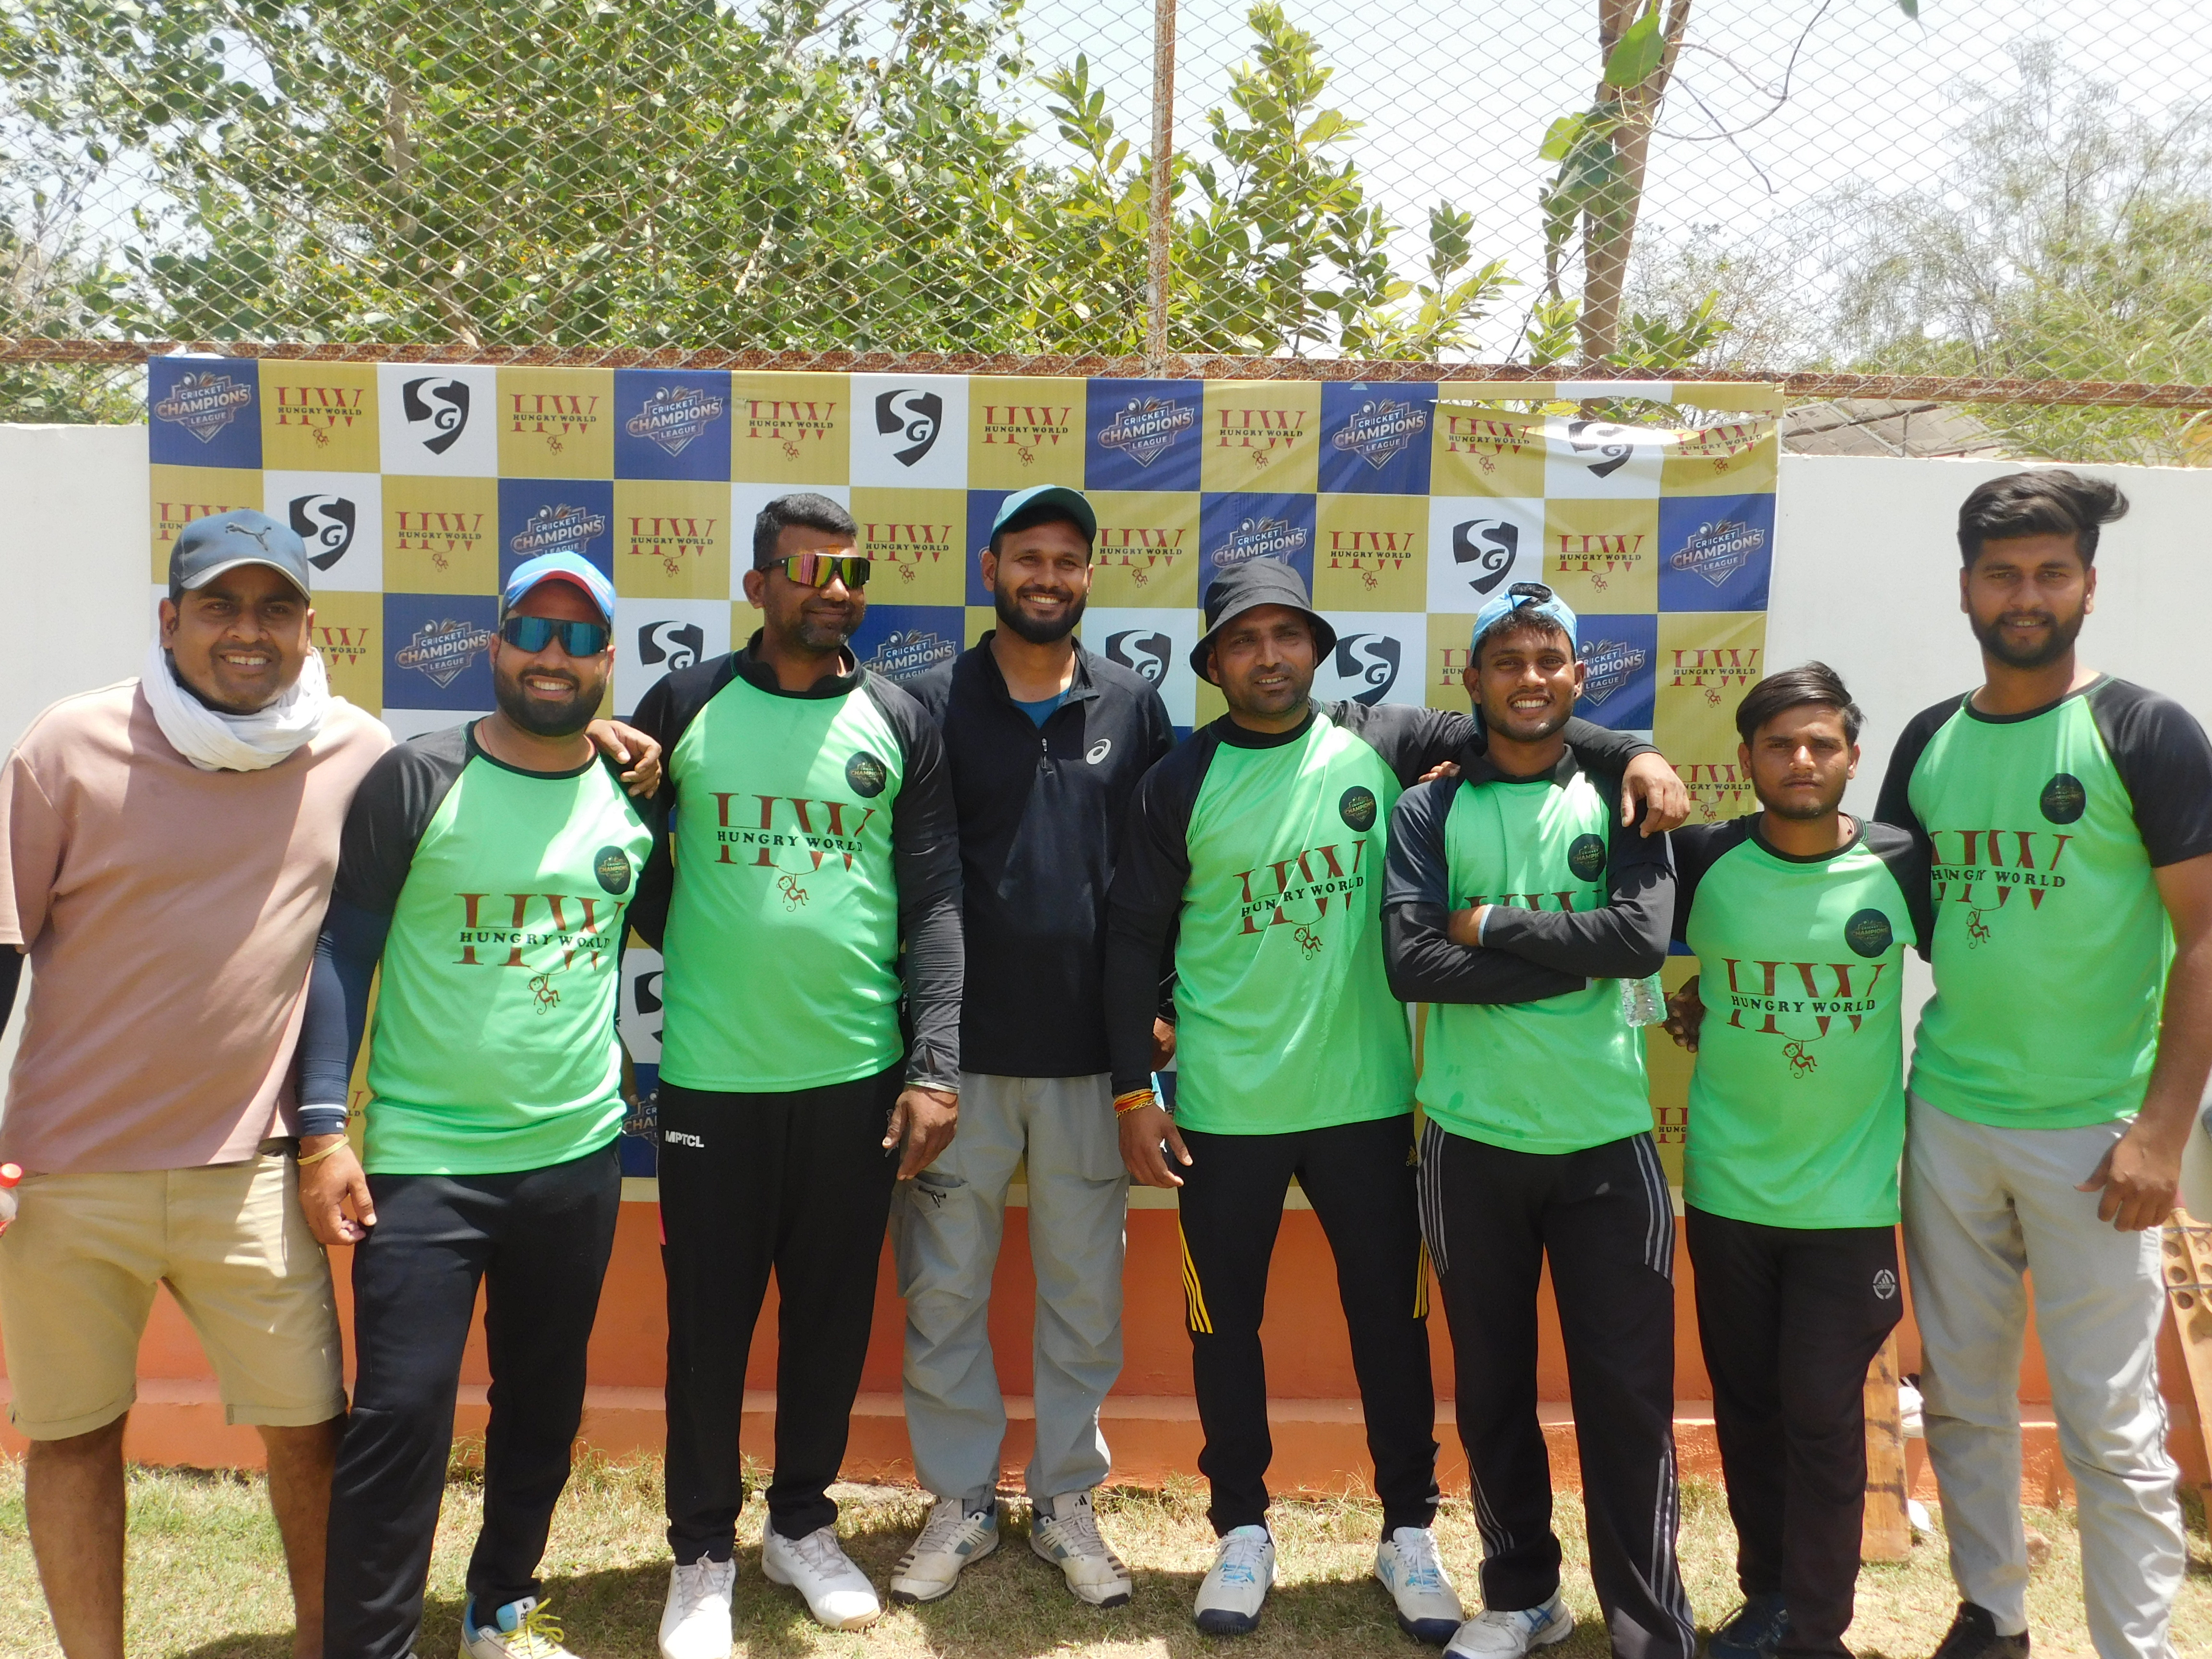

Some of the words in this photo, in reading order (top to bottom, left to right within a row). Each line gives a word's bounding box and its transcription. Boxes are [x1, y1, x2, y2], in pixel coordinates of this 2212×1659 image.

[180, 385, 221, 400] CRICKET
[157, 390, 249, 415] CHAMPIONS
[652, 399, 693, 415] CRICKET
[190, 412, 227, 425] LEAGUE
[628, 404, 720, 430] CHAMPIONS
[1124, 410, 1165, 425] CRICKET
[1358, 412, 1400, 428] CRICKET
[661, 425, 696, 438] LEAGUE
[1100, 413, 1192, 441] CHAMPIONS
[1334, 415, 1426, 444] CHAMPIONS
[1132, 436, 1167, 449] LEAGUE
[1366, 439, 1401, 452] LEAGUE
[1449, 435, 1490, 443] HUNGRY
[1493, 436, 1530, 445] WORLD
[1725, 434, 1762, 446] WORLD
[536, 517, 576, 532] CRICKET
[512, 521, 602, 548] CHAMPIONS
[1238, 529, 1279, 545] CRICKET
[1696, 533, 1735, 549] CRICKET
[545, 543, 579, 554] LEAGUE
[1214, 532, 1304, 563] CHAMPIONS
[1672, 536, 1763, 563] CHAMPIONS
[1703, 558, 1738, 571] LEAGUE
[421, 631, 462, 647] CRICKET
[397, 635, 489, 663] CHAMPIONS
[886, 642, 927, 657] CRICKET
[430, 659, 464, 671] LEAGUE
[1584, 654, 1642, 678] MPIONS
[1586, 676, 1619, 689] LEAGUE
[718, 831, 798, 846] HUNGRY
[806, 837, 863, 852] WORLD
[1995, 871, 2066, 887] WORLD
[1241, 889, 1306, 917] HUNRY
[1311, 877, 1364, 896] WORLD
[460, 932, 553, 945] HUNGRY
[1731, 996, 1804, 1012] HUNGRY
[1813, 999, 1875, 1013] WORLD
[665, 1130, 705, 1148] MPTCL
